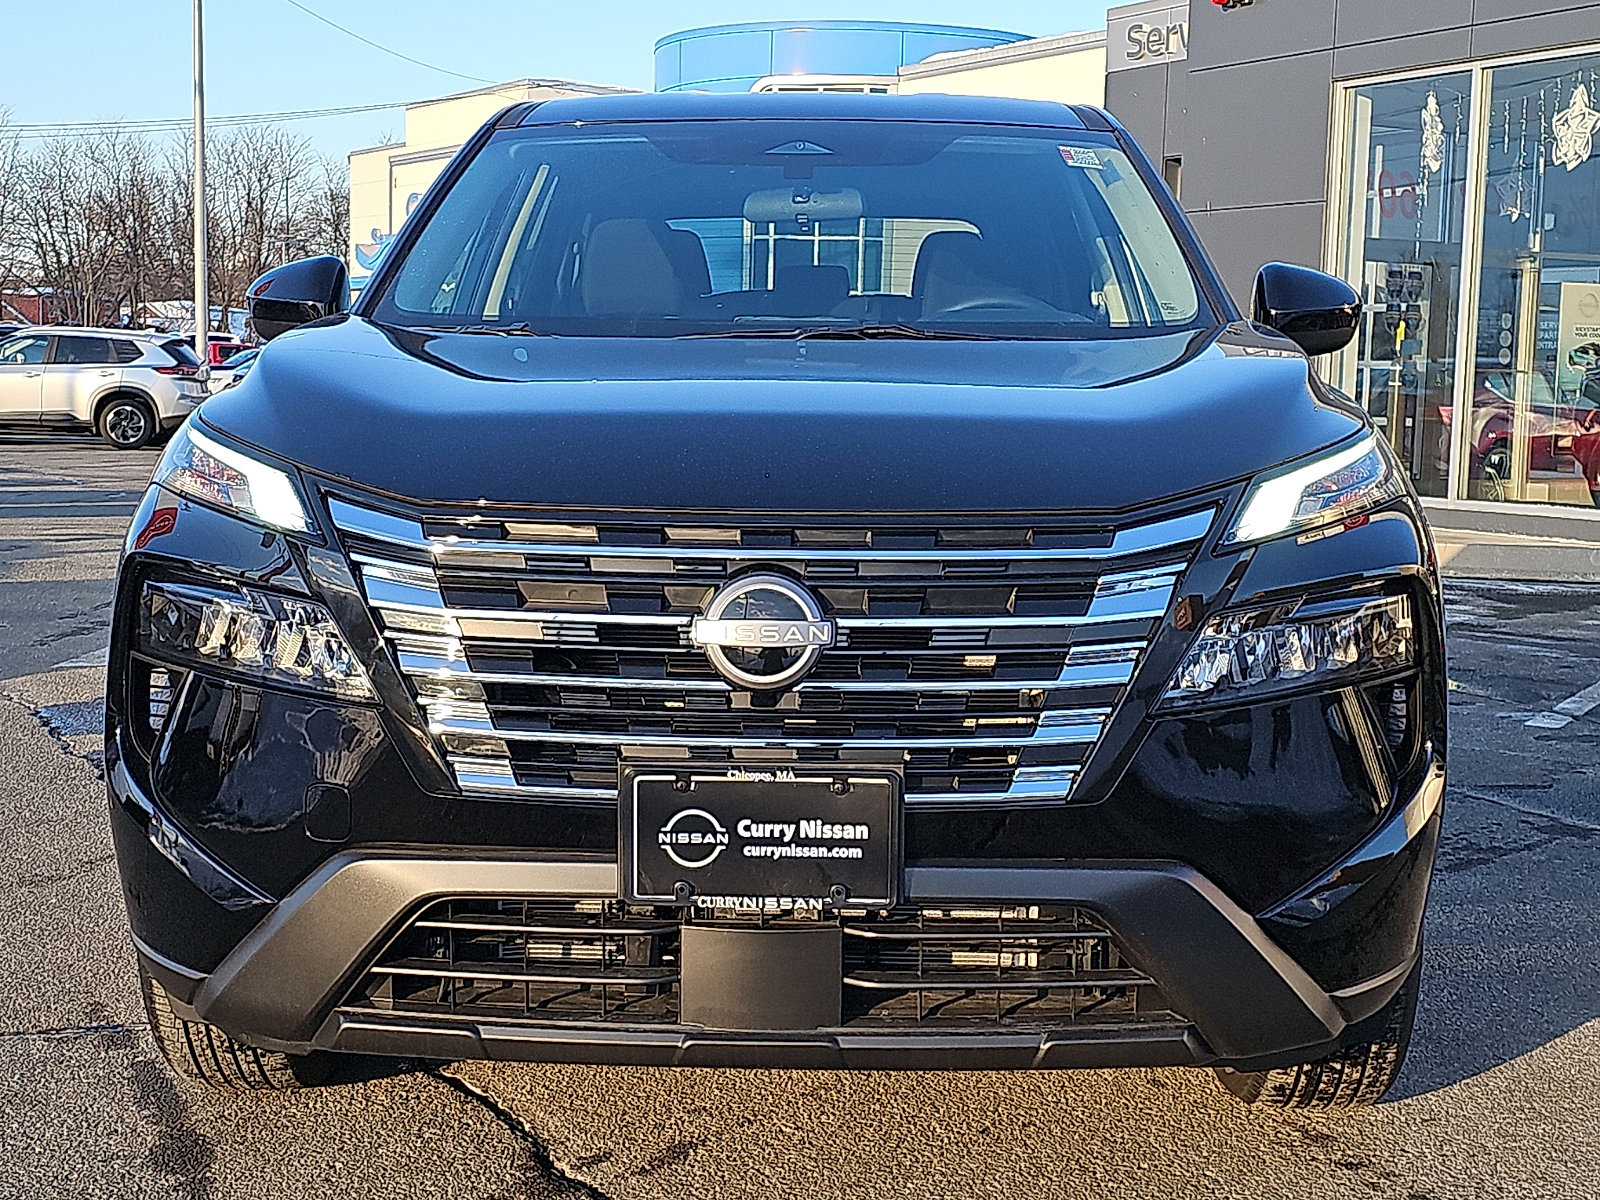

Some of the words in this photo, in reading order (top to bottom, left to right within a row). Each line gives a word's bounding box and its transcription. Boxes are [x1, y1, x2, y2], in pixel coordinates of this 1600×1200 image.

[699, 625, 830, 643] ISSAN
[775, 770, 796, 782] MA
[658, 832, 729, 844] NISSAN
[737, 819, 796, 842] Curry
[799, 819, 869, 840] Nissan
[742, 844, 863, 861] currynissan.com
